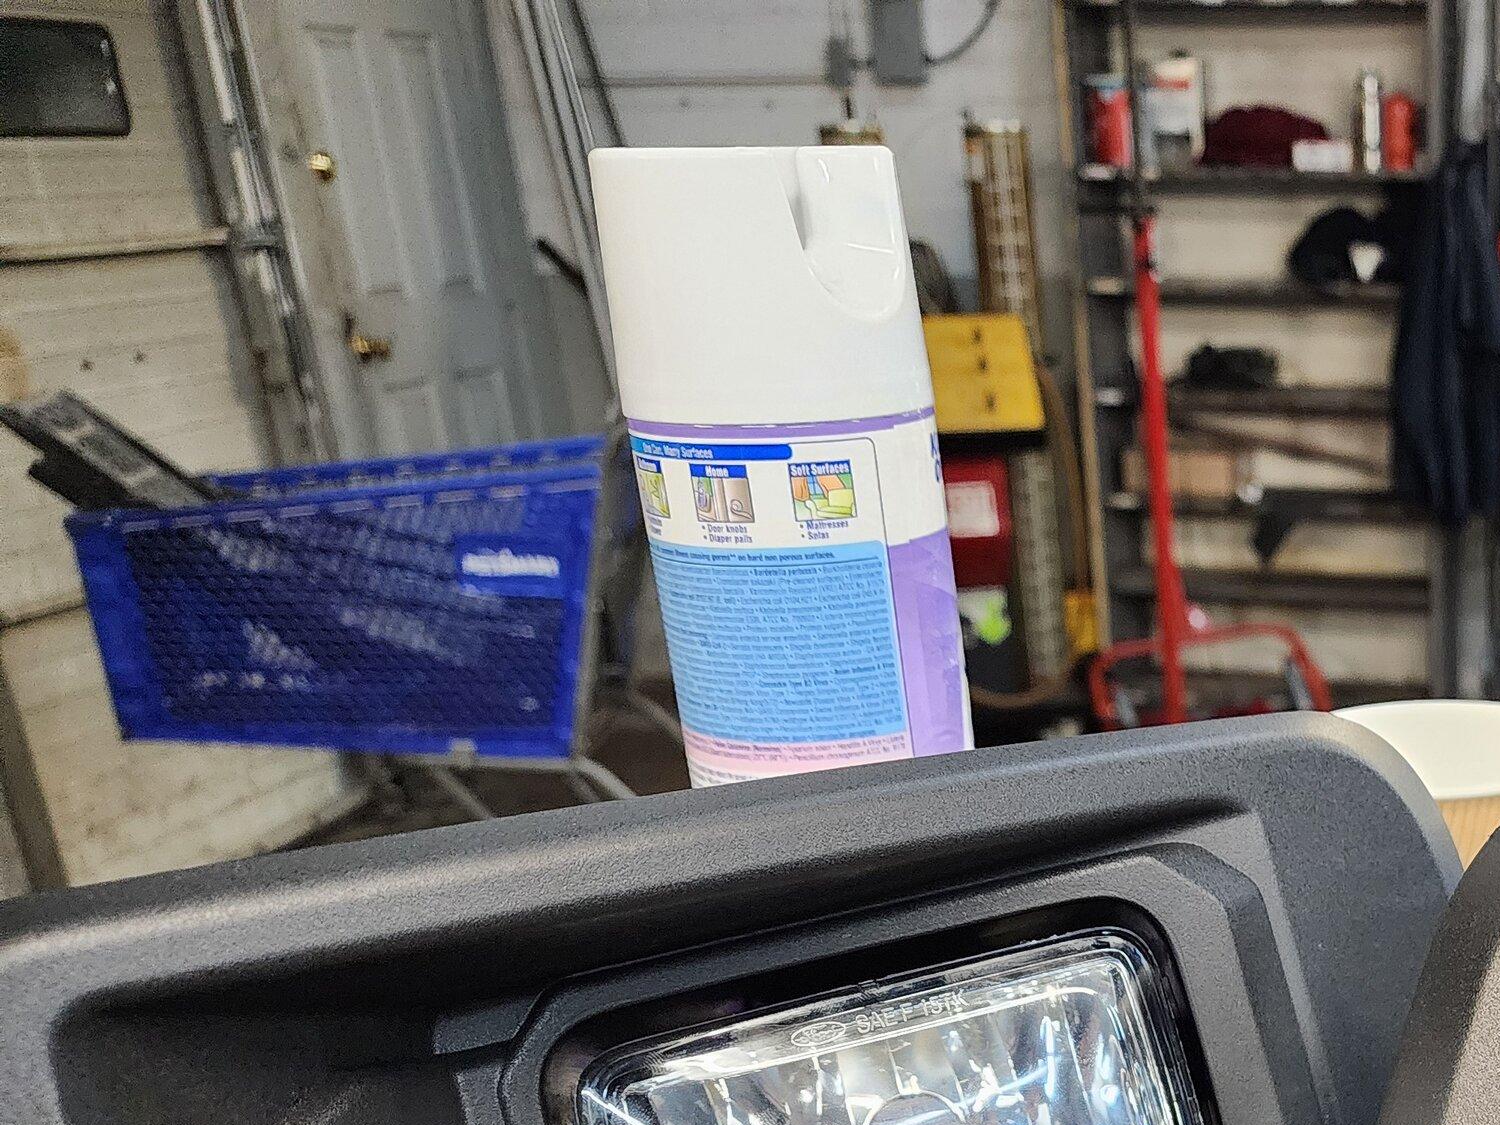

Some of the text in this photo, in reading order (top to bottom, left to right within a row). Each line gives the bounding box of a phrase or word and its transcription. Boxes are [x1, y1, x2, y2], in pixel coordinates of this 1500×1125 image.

[705, 466, 729, 477] Home
[791, 462, 849, 476] Soft Surfaces
[708, 525, 723, 533] Door
[855, 1006, 898, 1034] SAE
[900, 1002, 913, 1022] F
